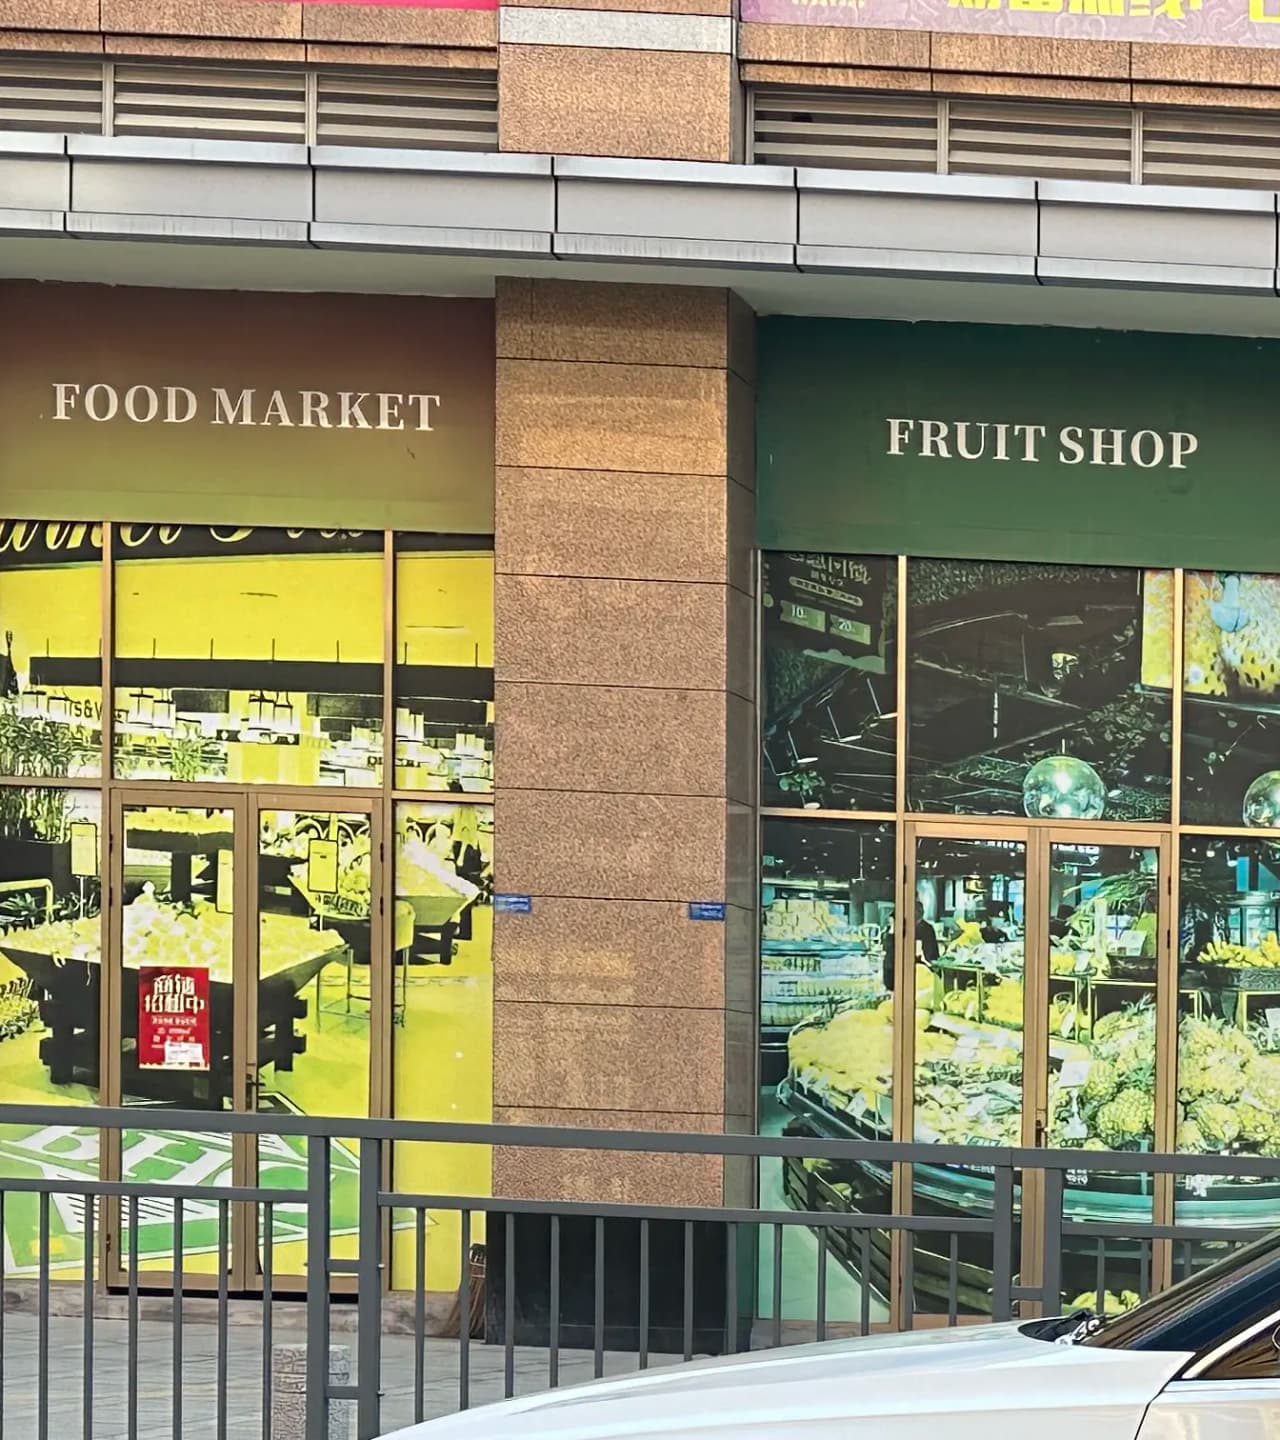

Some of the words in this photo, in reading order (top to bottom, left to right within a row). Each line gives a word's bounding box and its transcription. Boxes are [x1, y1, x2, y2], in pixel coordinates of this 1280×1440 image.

[52, 383, 198, 423] FOOD
[210, 387, 441, 432] MARKET
[886, 418, 1046, 462] FRUIT
[1058, 426, 1199, 469] SHOP
